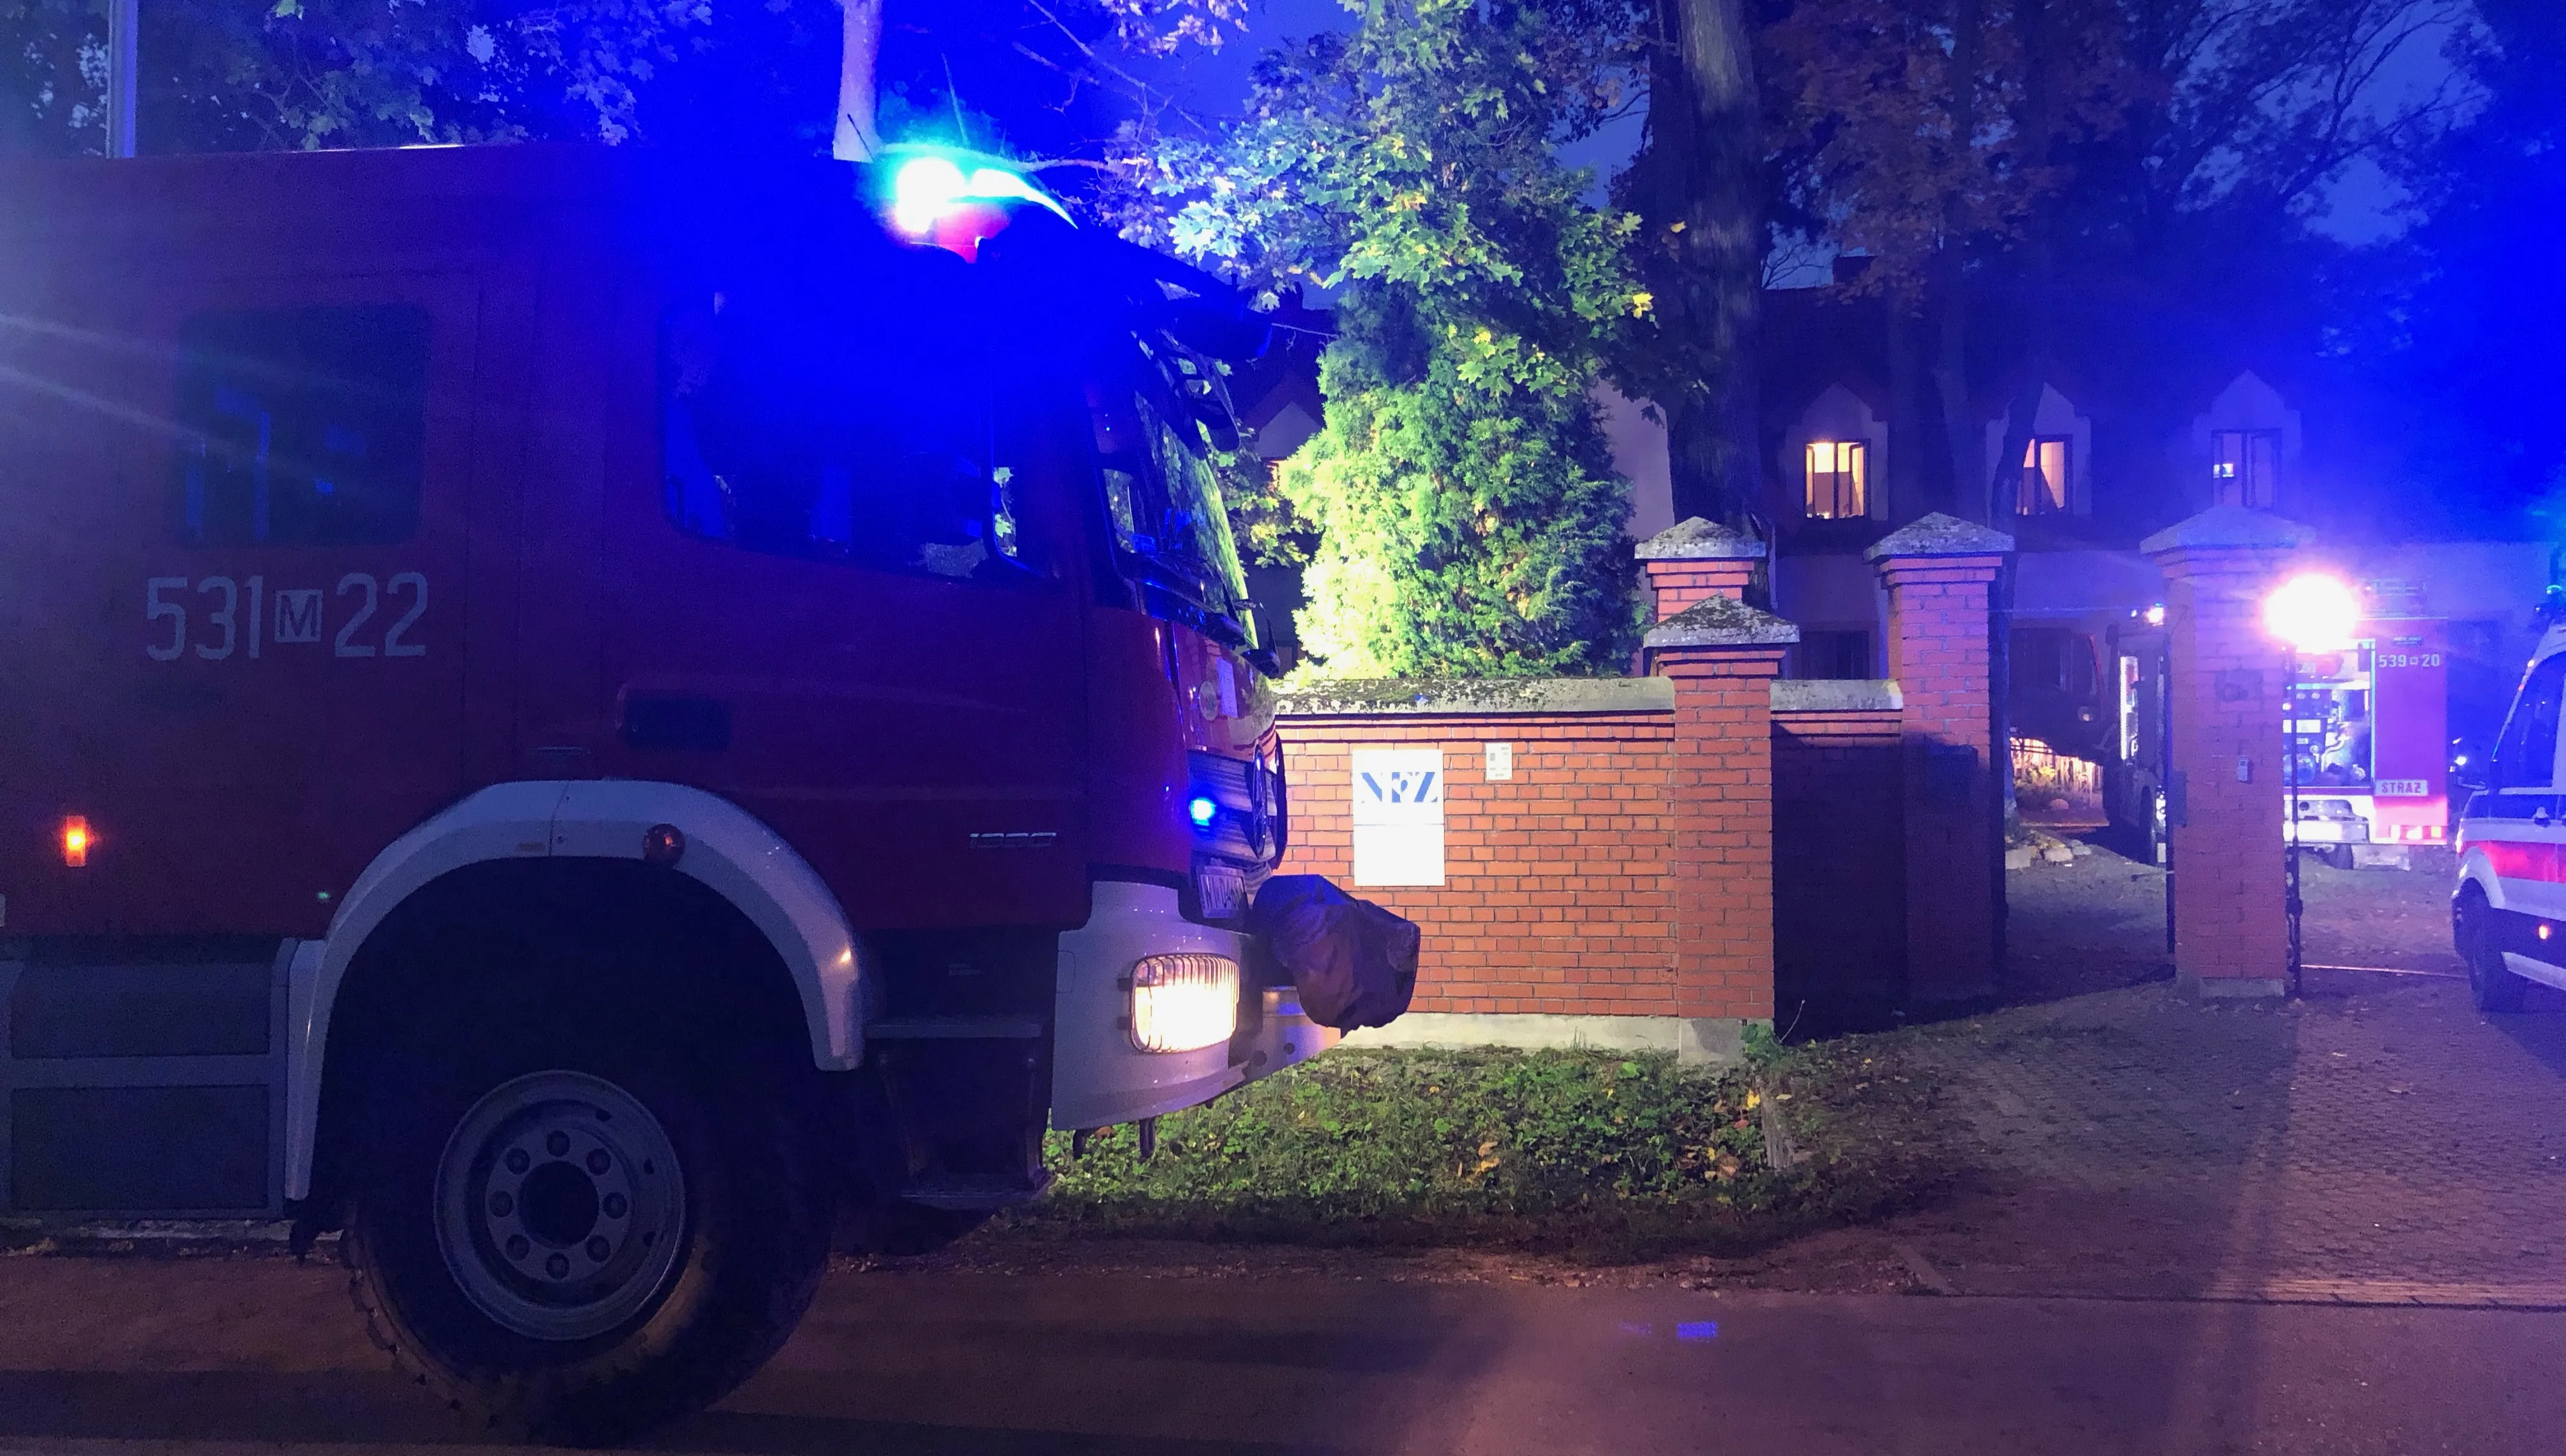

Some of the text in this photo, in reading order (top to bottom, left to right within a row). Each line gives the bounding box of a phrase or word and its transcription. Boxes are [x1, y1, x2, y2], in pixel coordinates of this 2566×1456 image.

[146, 571, 429, 661] 531 M 22
[2378, 654, 2407, 668] 539
[2422, 653, 2440, 667] 20
